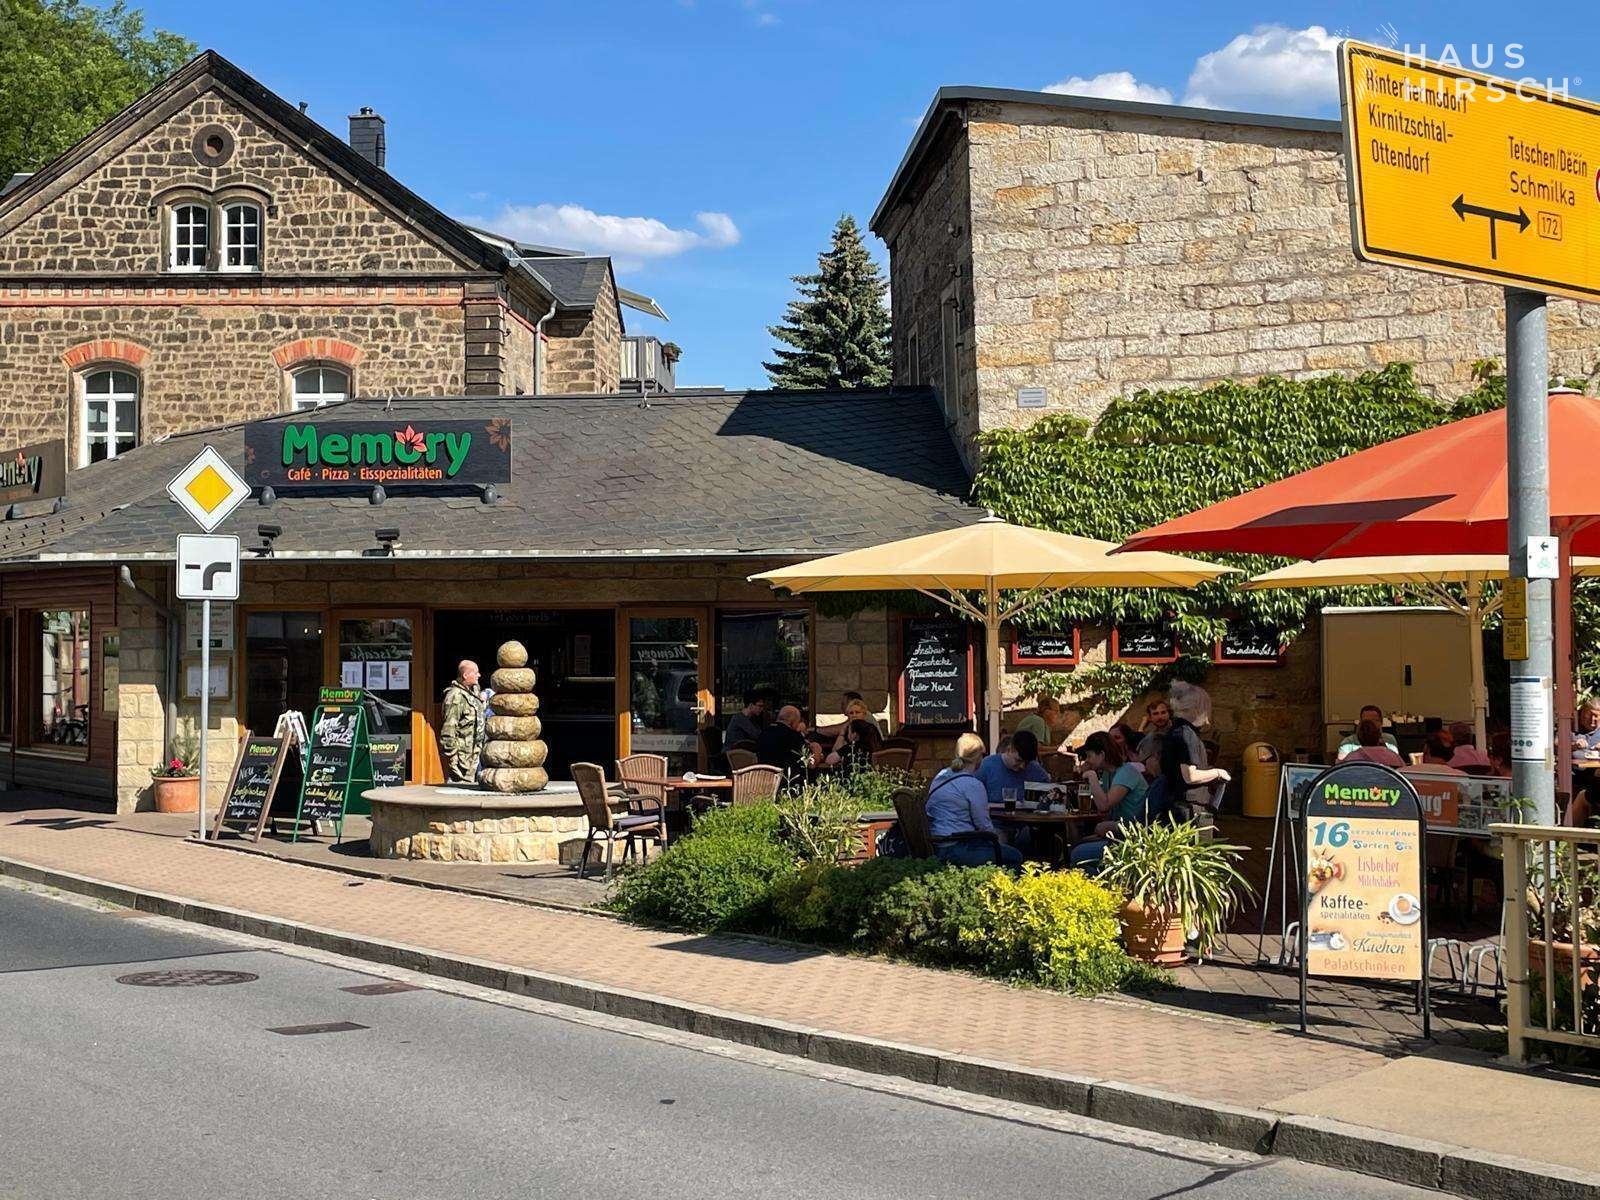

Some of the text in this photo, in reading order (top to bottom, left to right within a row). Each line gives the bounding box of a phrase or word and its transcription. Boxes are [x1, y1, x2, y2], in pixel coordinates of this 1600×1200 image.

[1368, 103, 1454, 143] Kirnitzschtal-
[1371, 138, 1430, 175] Ottendorf
[1508, 135, 1588, 177] Tetschen/Děčín
[1510, 170, 1576, 206] Schmilka
[1541, 216, 1559, 236] 172
[282, 424, 472, 476] Memory
[287, 467, 443, 482] Café Pizza Eisspezialitäten
[321, 688, 361, 702] Memory
[249, 744, 278, 756] Memory
[1324, 783, 1401, 806] Memory
[1313, 821, 1351, 848] 16
[1320, 895, 1369, 910] Kaffee-
[1324, 958, 1405, 973] Palatschinken
